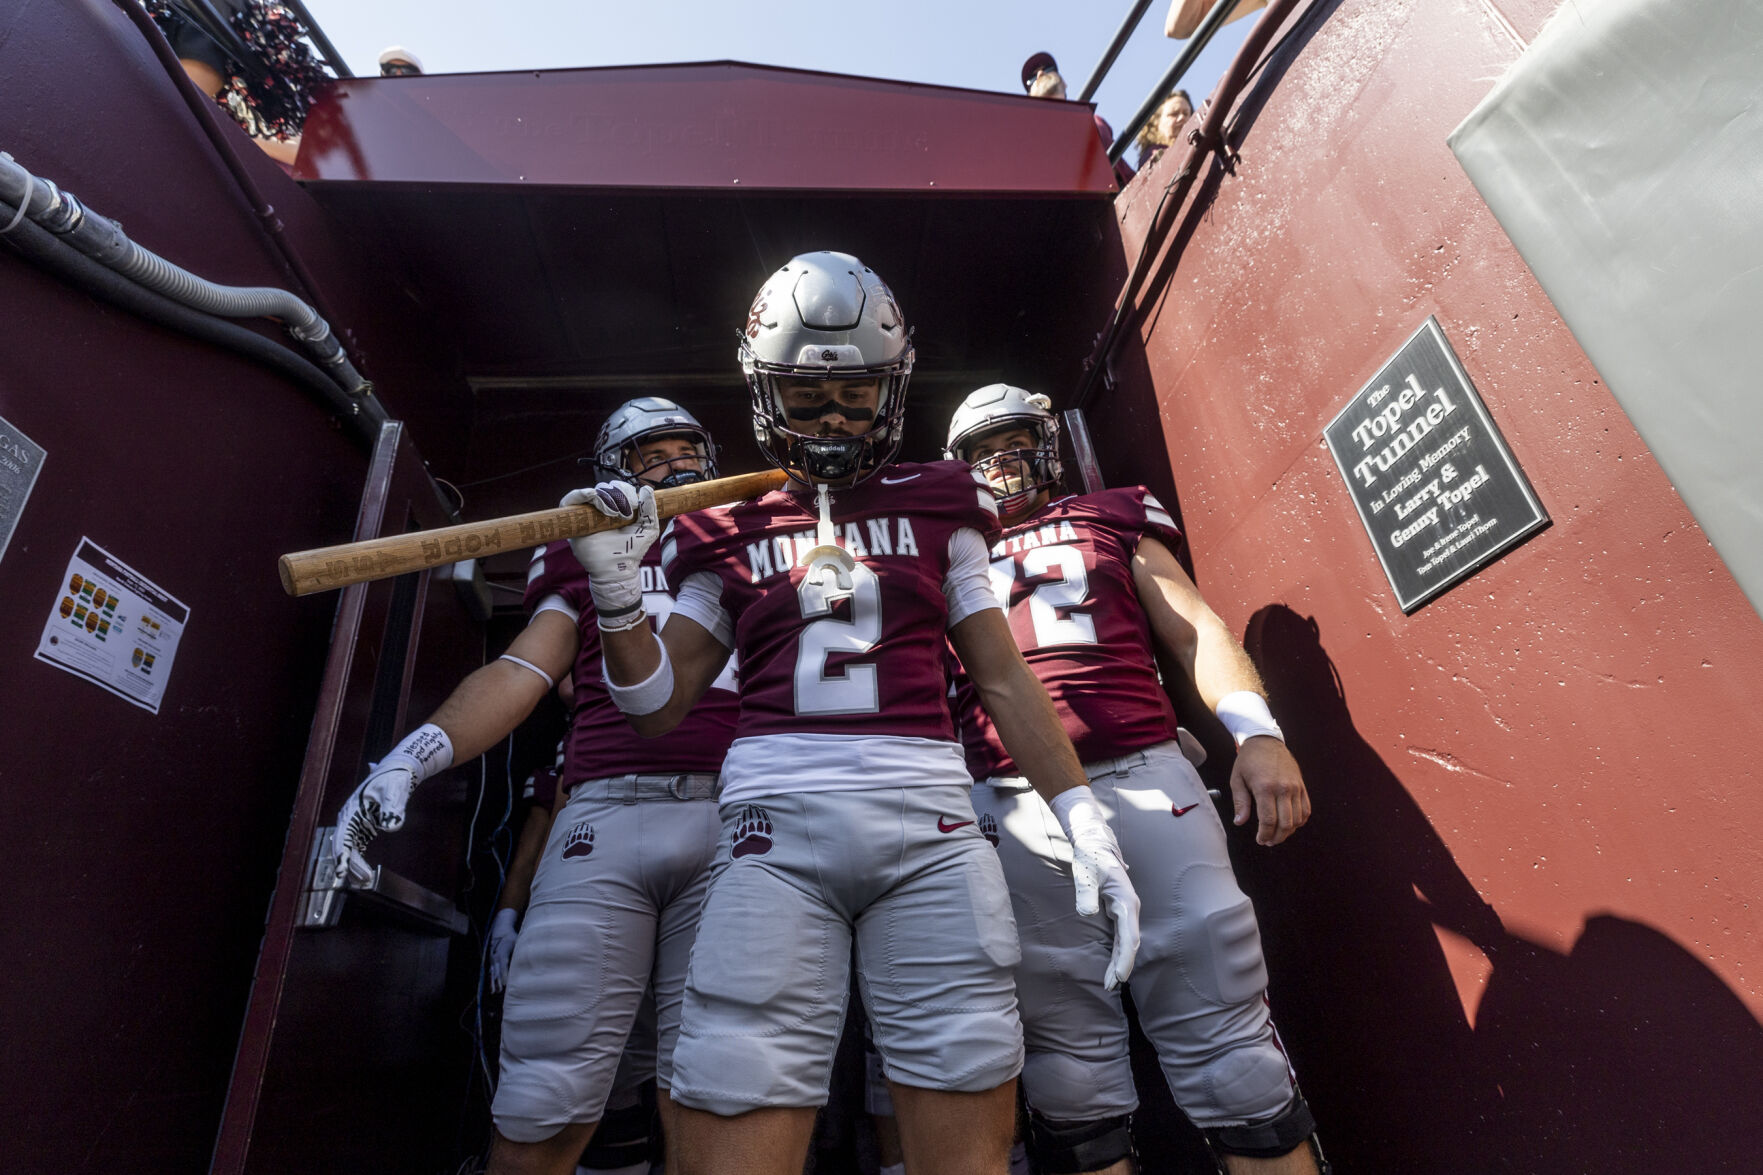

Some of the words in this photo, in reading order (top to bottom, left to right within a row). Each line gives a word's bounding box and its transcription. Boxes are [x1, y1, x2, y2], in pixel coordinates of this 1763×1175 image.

[1352, 373, 1427, 452] Topel
[1367, 383, 1390, 408] The
[1353, 388, 1457, 489] Tunnel
[1370, 500, 1383, 514] In
[1382, 469, 1421, 505] Loving
[1420, 426, 1471, 473] Memory
[1390, 508, 1438, 549] Genny
[1437, 466, 1490, 510] Topel
[1394, 479, 1439, 520] Larry
[1441, 463, 1459, 484] &
[420, 529, 501, 565] YOUR
[746, 517, 919, 583] MONANA
[1416, 562, 1431, 576] Tom
[1431, 550, 1449, 566] Topel
[1449, 545, 1456, 554] &
[1456, 532, 1474, 549] Lauri
[1474, 518, 1497, 535] Thom
[1423, 548, 1434, 559] Joe
[1434, 541, 1440, 549] &
[1440, 529, 1459, 545] Irene
[1459, 513, 1480, 533] Topel
[794, 561, 883, 716] 2
